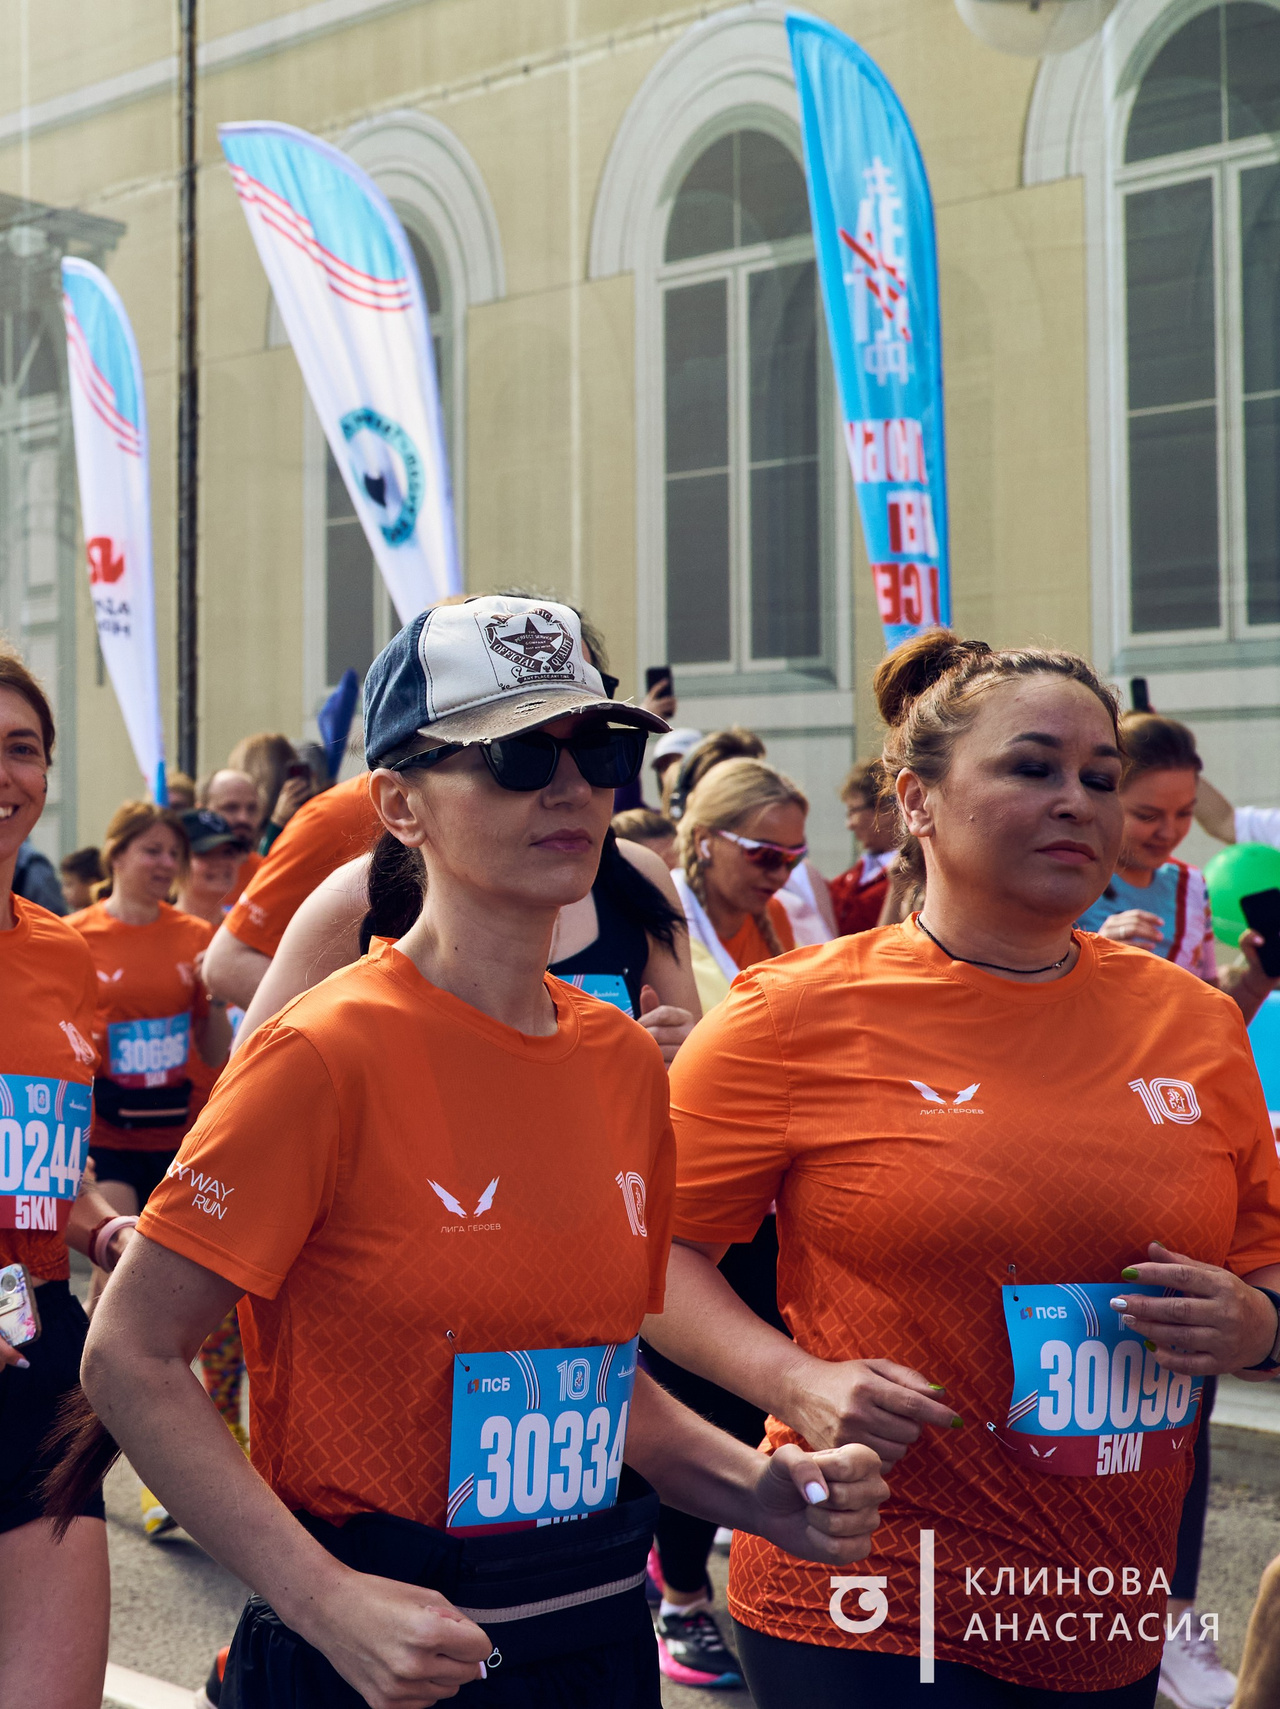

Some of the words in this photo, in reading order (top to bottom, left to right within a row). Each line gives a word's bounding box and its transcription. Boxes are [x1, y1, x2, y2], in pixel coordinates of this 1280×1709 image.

[493, 643, 535, 668] OFFICIAL
[1128, 1077, 1201, 1125] 10
[191, 1193, 228, 1220] RUN
[440, 1225, 465, 1234] ЛИГА
[467, 1223, 502, 1232] ГЕРОЕВ
[1035, 1306, 1068, 1320] ПСБ
[481, 1377, 511, 1393] ПСБ
[476, 1400, 629, 1518] 30334
